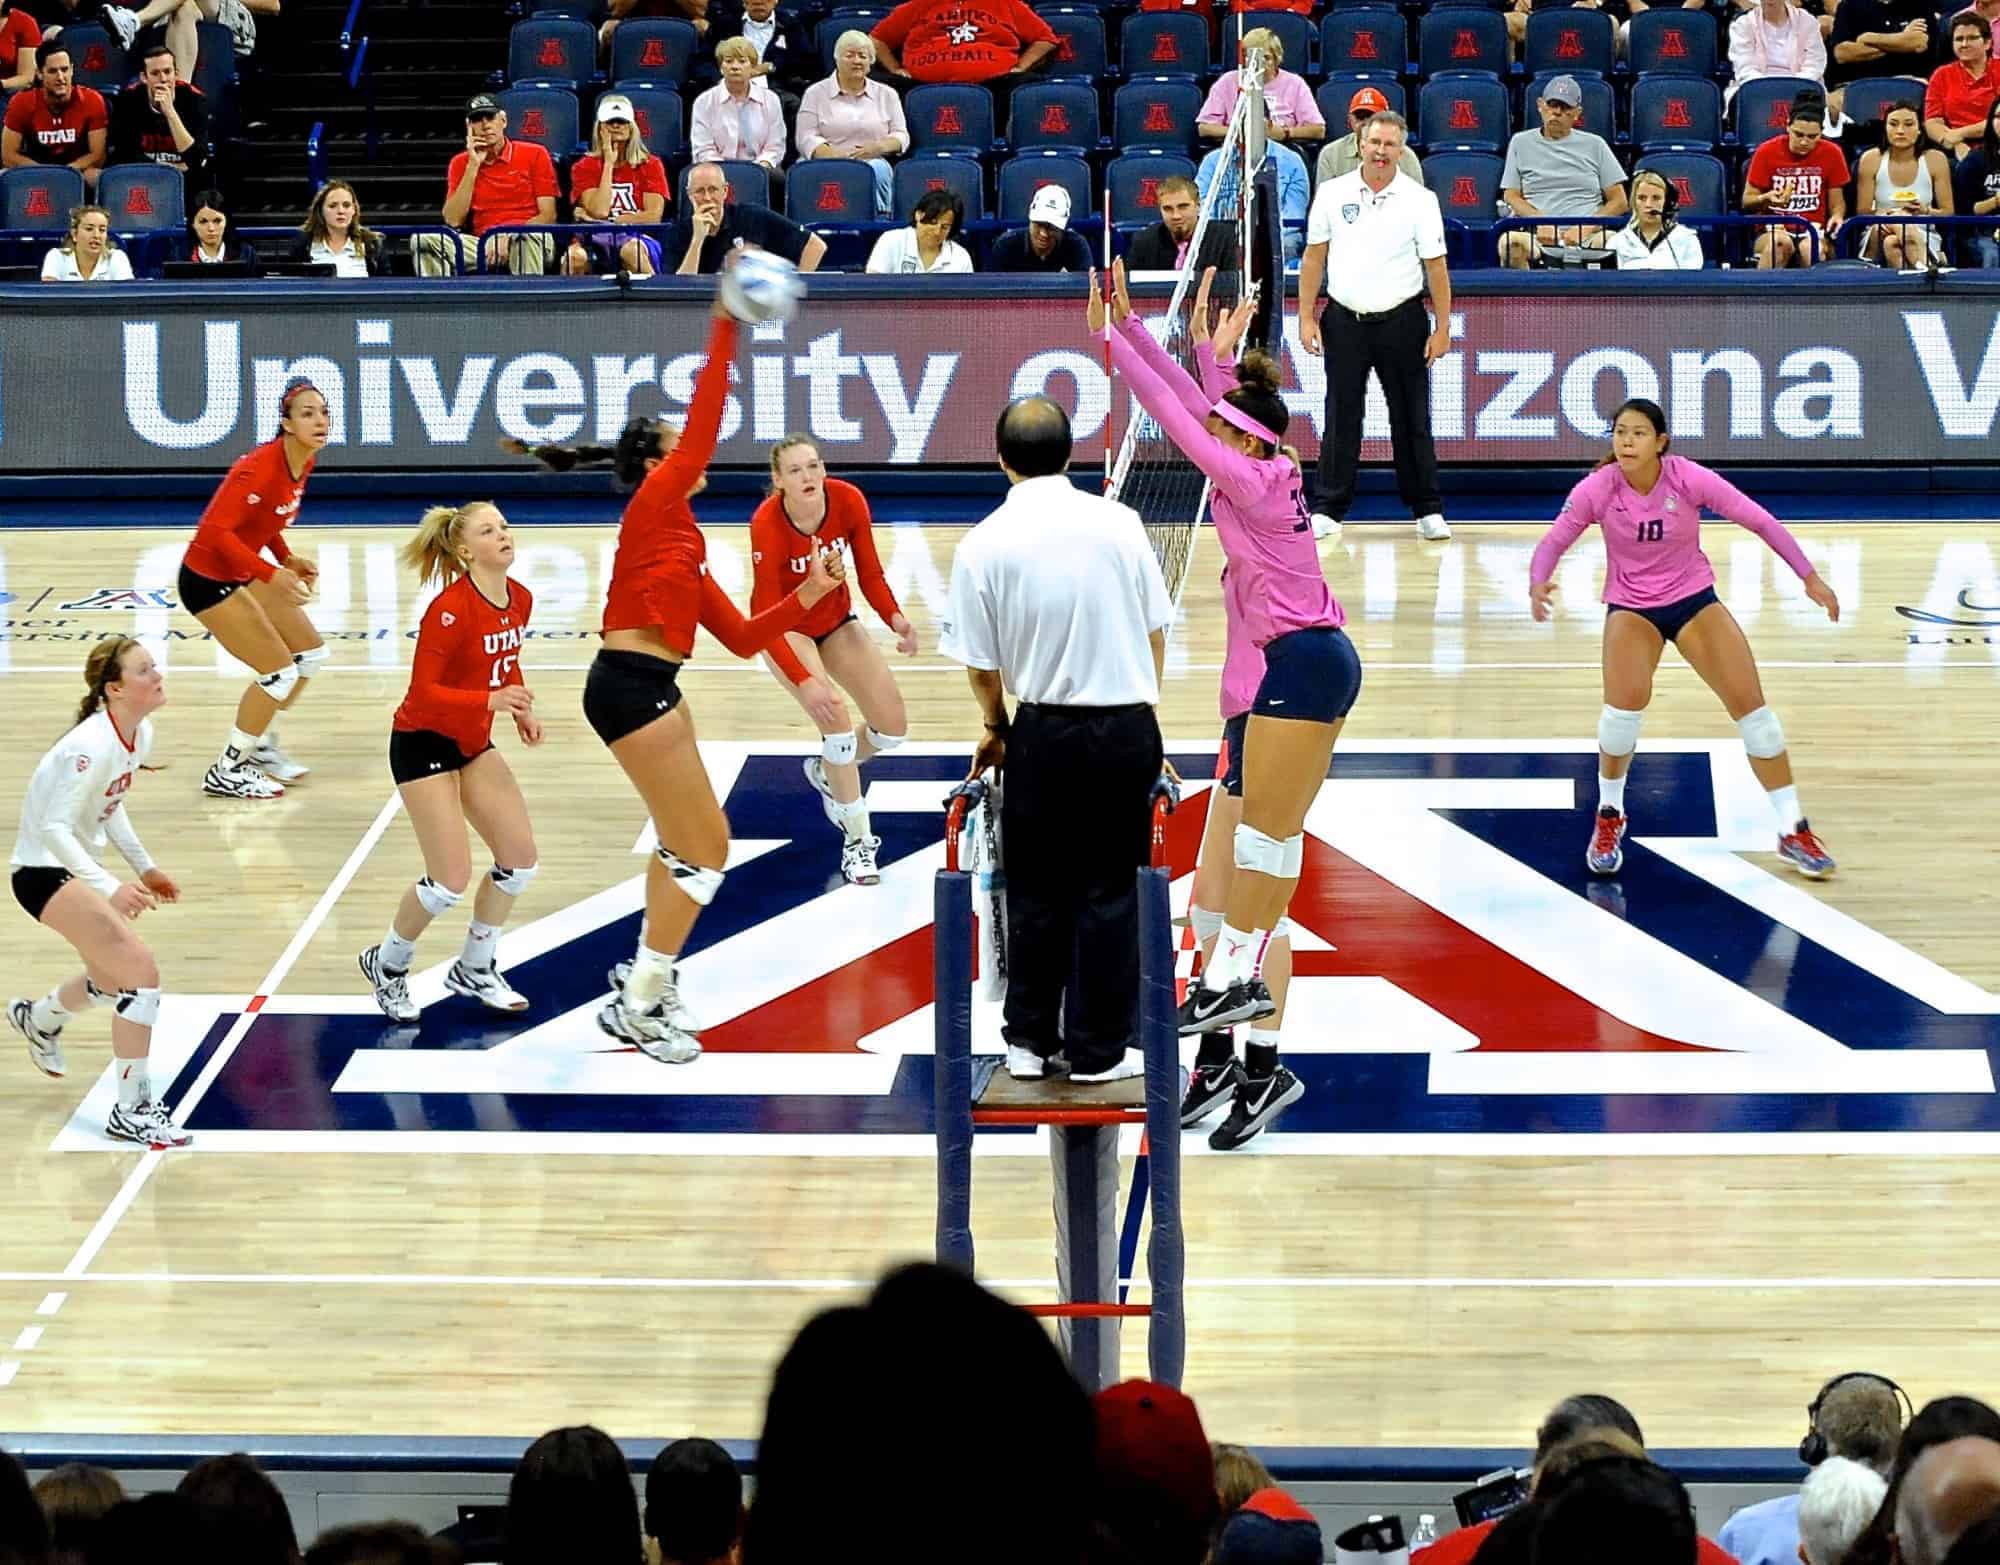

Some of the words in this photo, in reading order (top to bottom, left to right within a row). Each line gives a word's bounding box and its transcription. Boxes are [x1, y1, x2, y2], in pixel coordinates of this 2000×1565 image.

[38, 129, 76, 144] UTAH
[123, 318, 962, 464] University
[1637, 519, 1664, 543] 10
